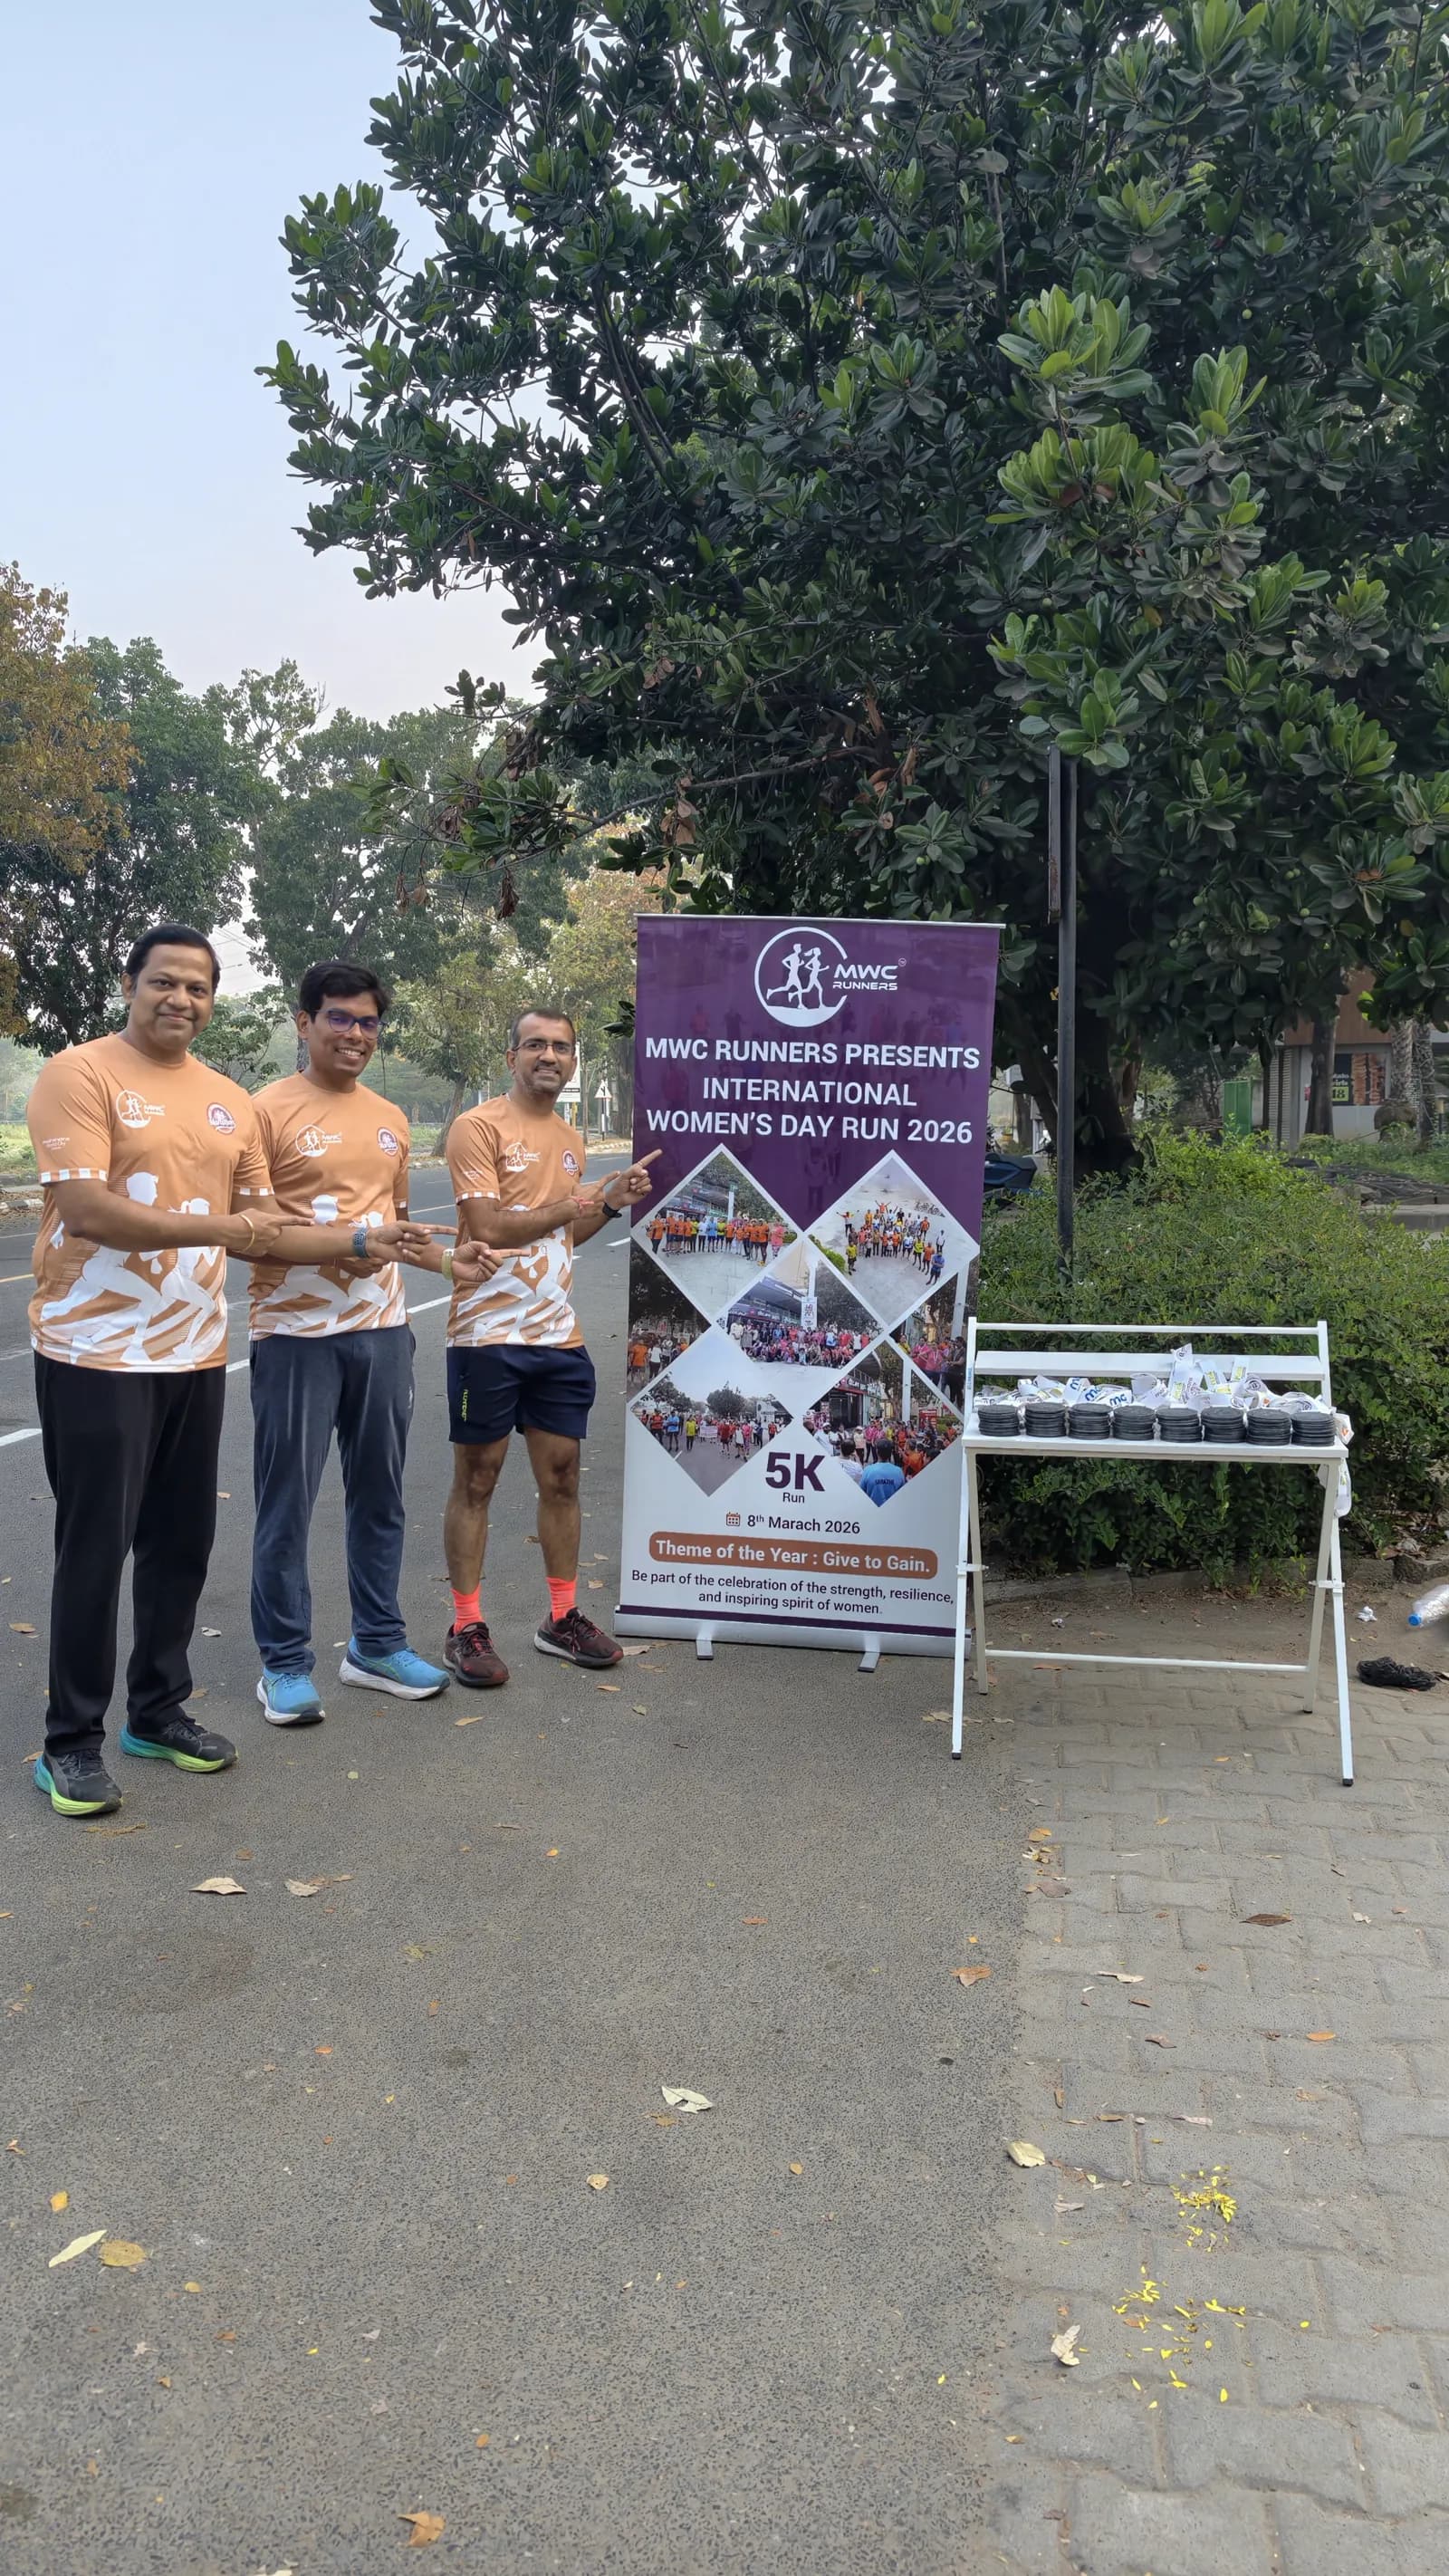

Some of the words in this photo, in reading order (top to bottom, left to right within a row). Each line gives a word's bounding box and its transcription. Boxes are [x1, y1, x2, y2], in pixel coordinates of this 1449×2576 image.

[834, 964, 897, 979] MWC
[833, 982, 897, 990] RUNNERS
[647, 1038, 707, 1059] MWC
[715, 1040, 837, 1063] RUNNERS
[846, 1043, 980, 1069] PRESENTS
[704, 1078, 916, 1106] INTERNATIONAL
[647, 1110, 772, 1135] WOMEN’S
[782, 1115, 834, 1137] DAY
[842, 1117, 898, 1139] RUN
[907, 1120, 972, 1143] 2026
[765, 1452, 825, 1492] 5K
[783, 1492, 805, 1504] Run
[748, 1515, 764, 1527] 8th
[769, 1516, 820, 1532] Marach
[825, 1521, 859, 1533] 2026
[656, 1540, 711, 1557] Theme
[716, 1543, 734, 1558] of
[738, 1545, 764, 1561] the
[771, 1548, 808, 1563] Year
[823, 1552, 859, 1567] Give
[865, 1555, 881, 1569] to
[888, 1556, 929, 1572] Gain.
[632, 1570, 648, 1581] Be
[651, 1572, 676, 1586] part
[678, 1572, 692, 1584] of
[695, 1573, 715, 1586] the
[718, 1576, 787, 1591] celebration
[791, 1581, 803, 1591] of
[807, 1581, 827, 1593] the
[830, 1583, 887, 1600] strength,
[890, 1587, 955, 1605] resilience,
[699, 1591, 721, 1602] and
[725, 1592, 778, 1609] inspiring
[782, 1597, 813, 1610] spirit
[818, 1599, 830, 1610] of
